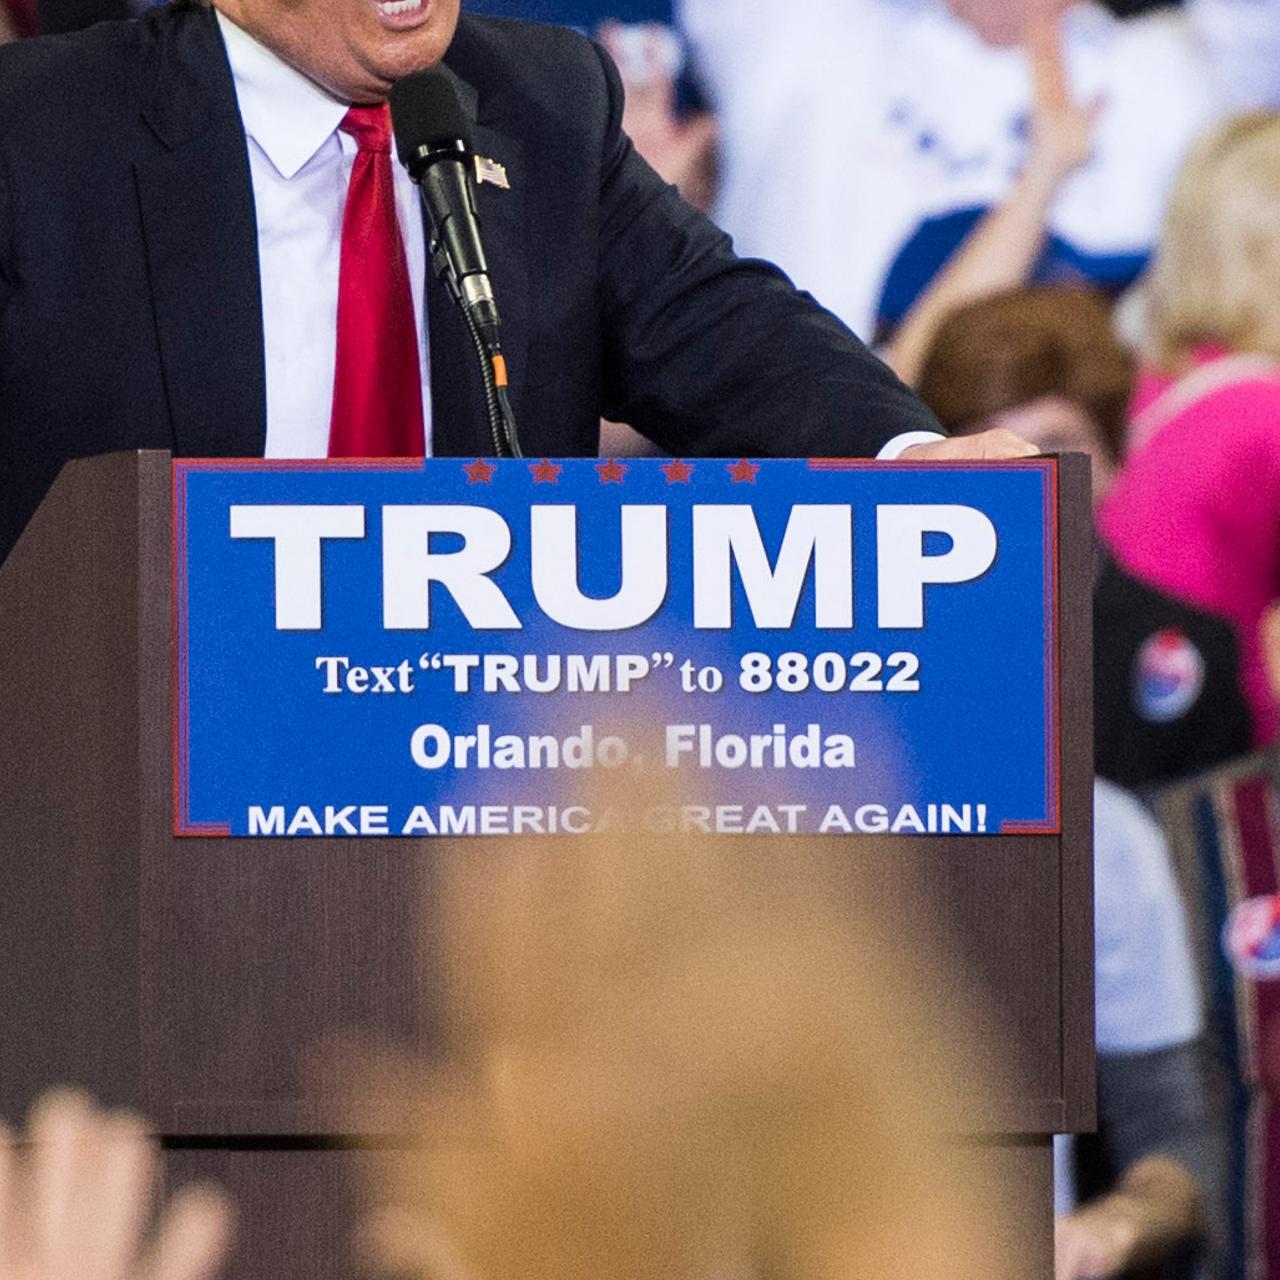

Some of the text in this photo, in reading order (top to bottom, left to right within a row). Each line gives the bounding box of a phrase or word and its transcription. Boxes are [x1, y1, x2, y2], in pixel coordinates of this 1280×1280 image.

[230, 504, 998, 631] TRUMP
[316, 657, 414, 693] Text
[680, 658, 723, 693] to
[739, 651, 920, 693] 88022
[665, 723, 856, 769] Florida
[248, 805, 389, 835] MAKE
[819, 803, 987, 833] AGAIN!
